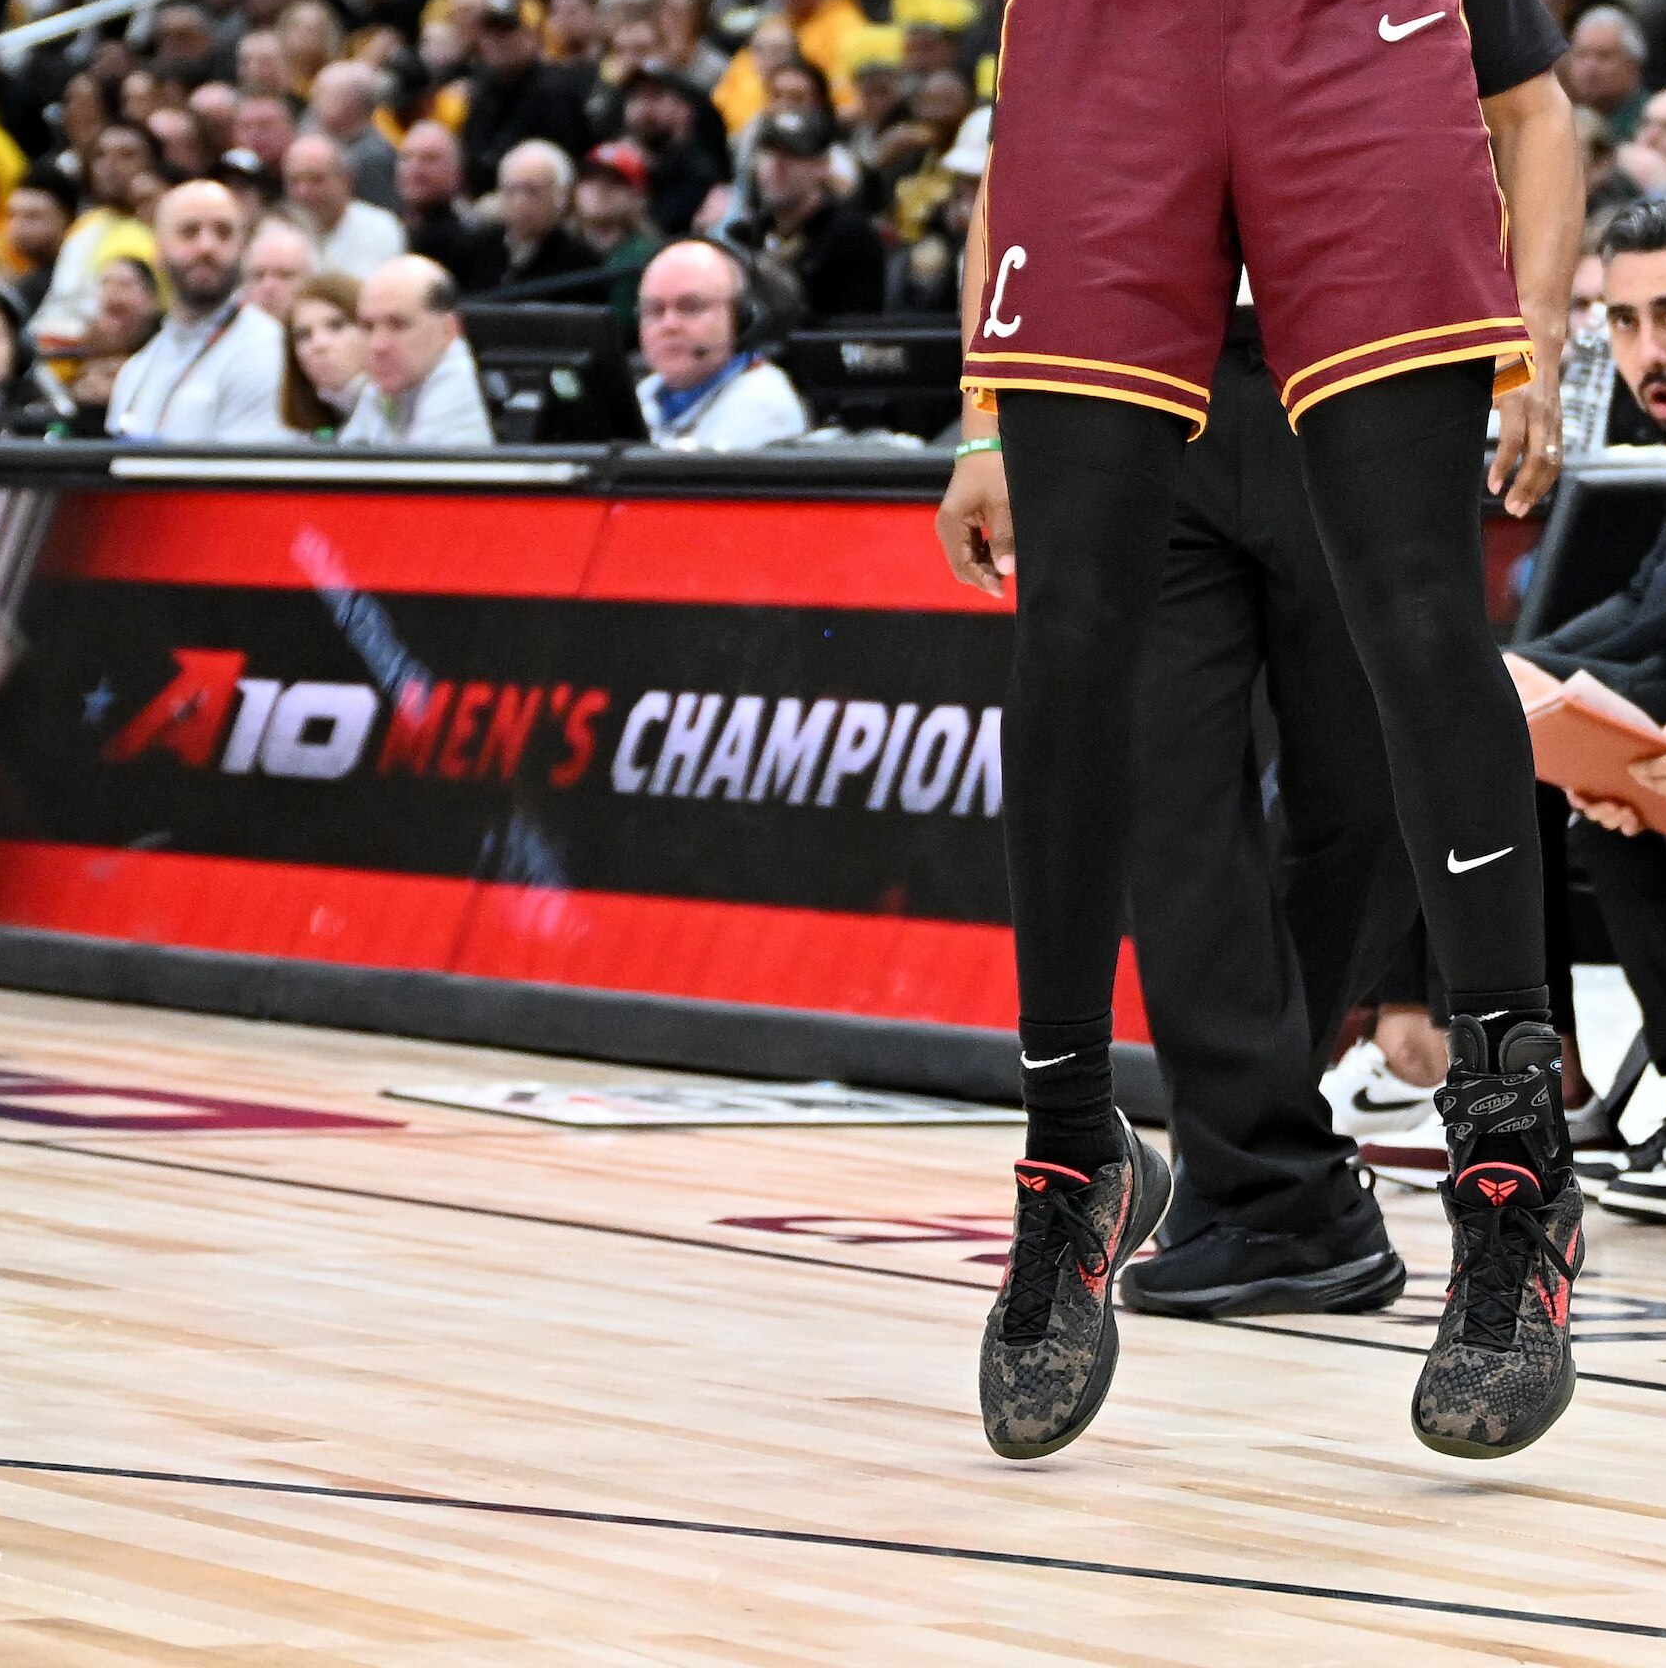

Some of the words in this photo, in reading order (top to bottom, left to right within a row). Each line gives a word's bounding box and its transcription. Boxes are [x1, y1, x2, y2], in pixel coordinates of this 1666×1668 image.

[983, 244, 1027, 339] L
[101, 648, 379, 781] A10
[377, 679, 611, 790] MEN'S
[1474, 1093, 1514, 1112] ULTRA
